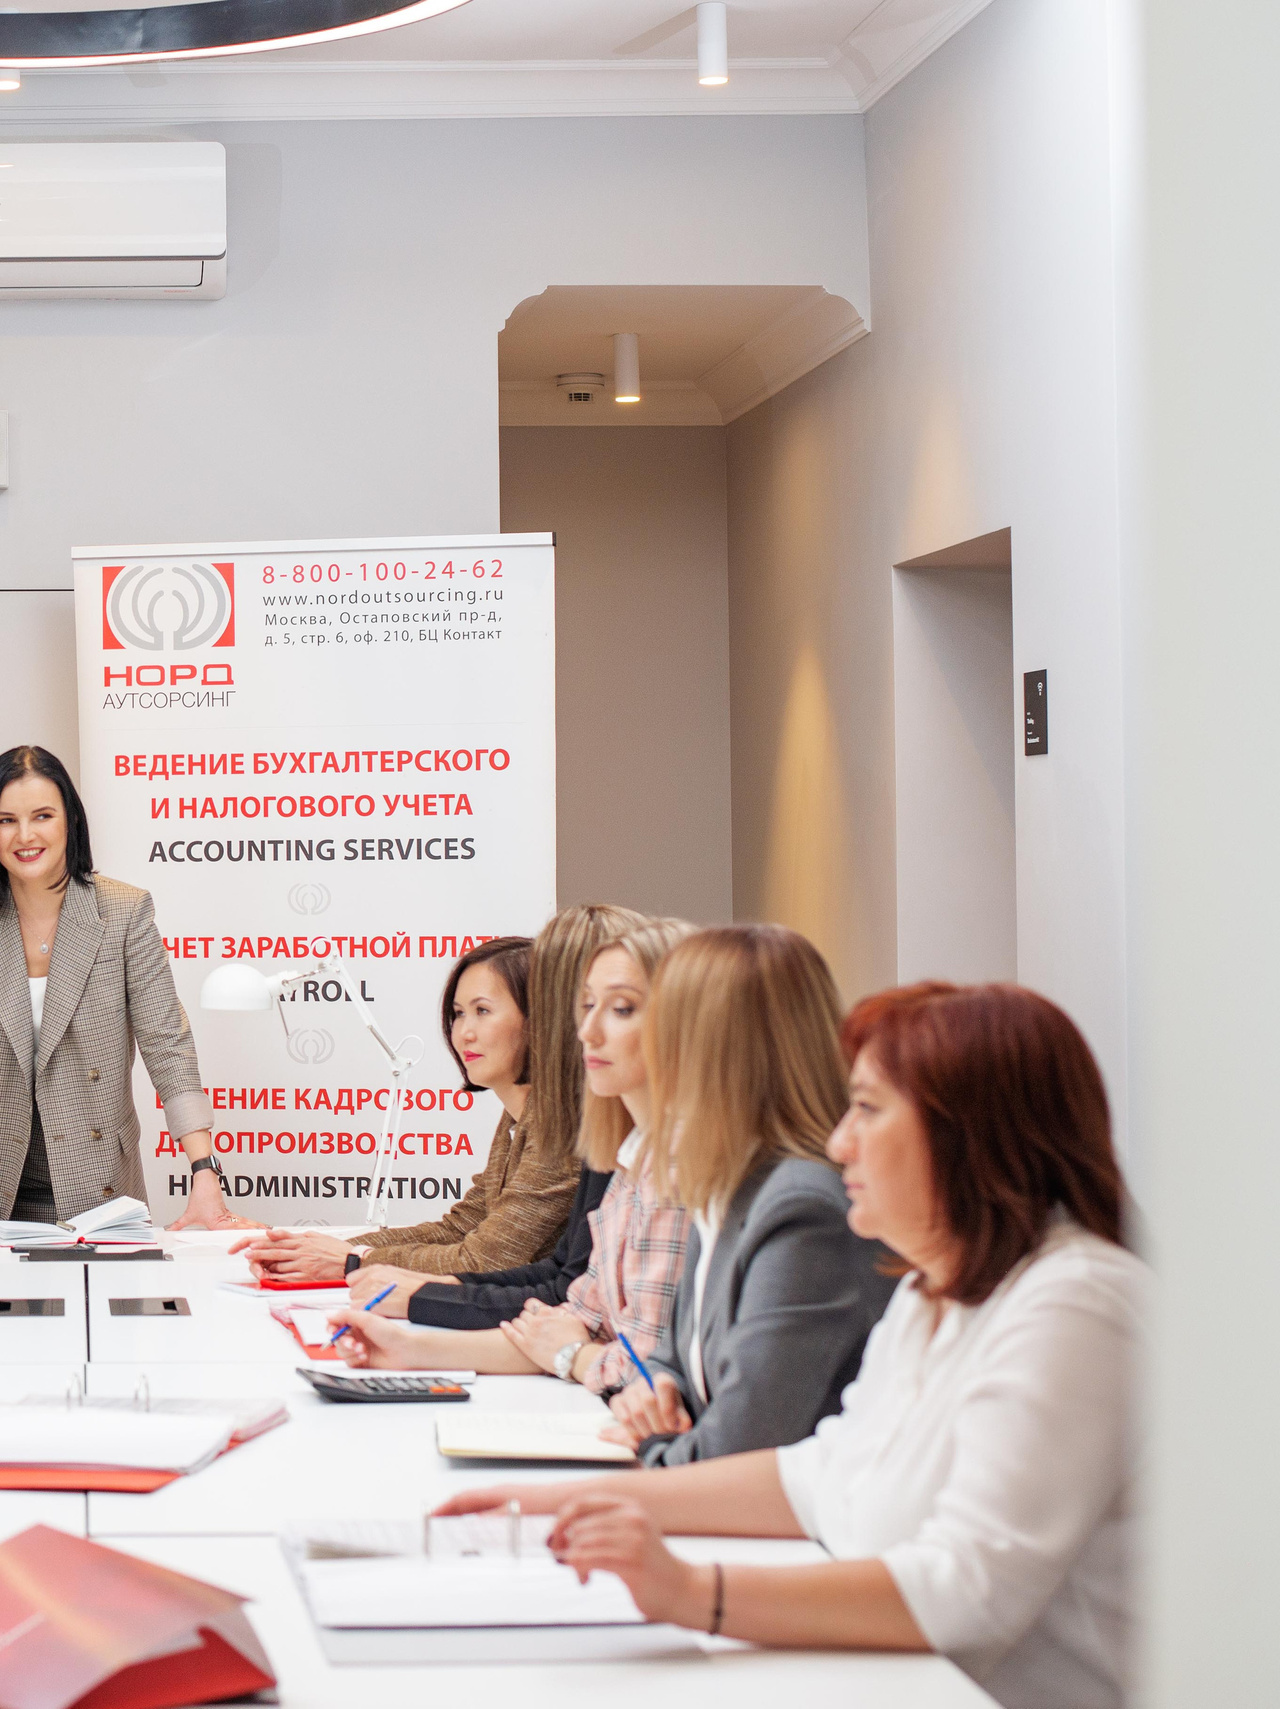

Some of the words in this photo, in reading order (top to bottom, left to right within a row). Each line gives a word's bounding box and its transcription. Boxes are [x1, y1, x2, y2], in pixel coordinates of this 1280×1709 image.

[262, 559, 503, 584] 8-800-100-24-62
[262, 588, 503, 606] www.nordoutsourcing.ru
[264, 613, 333, 626] Москва,
[339, 610, 451, 625] Остаповский
[459, 610, 502, 624] пр-д,
[264, 635, 278, 647] д.
[283, 632, 295, 646] 5,
[301, 634, 330, 647] стр.
[335, 631, 348, 645] 6,
[353, 630, 378, 646] оф.
[383, 629, 414, 643] 210,
[419, 629, 439, 643] БЦ
[443, 629, 502, 641] Контакт
[103, 663, 235, 688] НОРД
[102, 690, 237, 710] АУТСОРСИНГ
[114, 752, 245, 781] ВЕДЕНИЕ
[252, 748, 511, 775] БУХГАЛТЕРСКОГО
[150, 797, 170, 820] И
[178, 795, 376, 819] НАЛОГОВОГО
[383, 794, 474, 817] УЧЕТА
[148, 838, 336, 862] ACCOUNTING
[343, 837, 476, 861] SERVICES
[162, 937, 215, 959] ЧЕТ
[221, 931, 411, 959] ЗАРАБОТНОЙ
[294, 1087, 475, 1116] КАДРОВОГО
[219, 1175, 462, 1200] ADMINISTRATION
